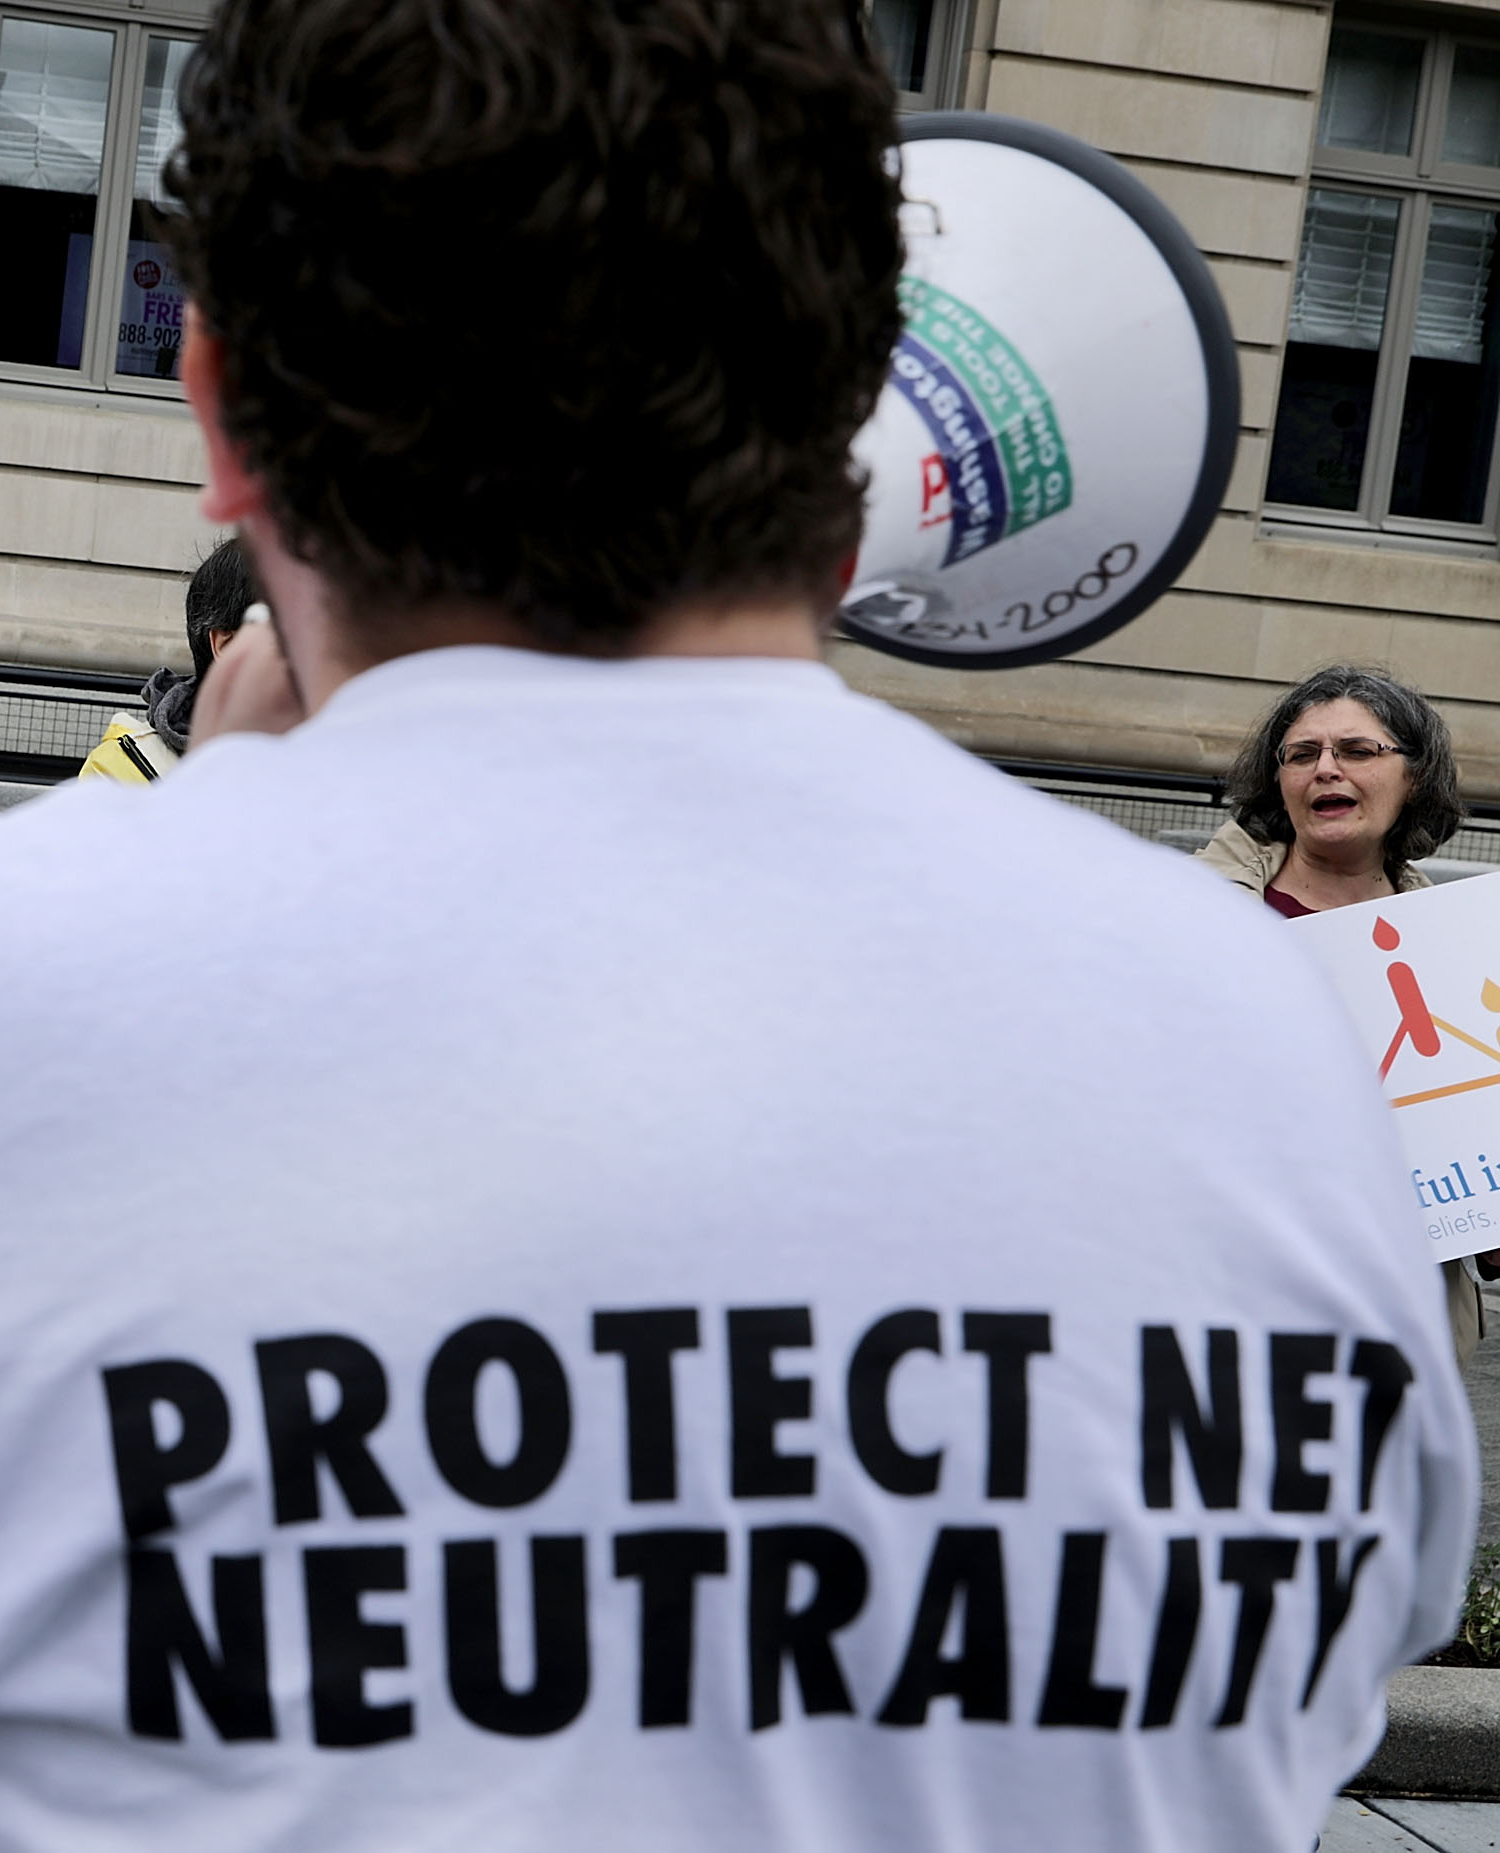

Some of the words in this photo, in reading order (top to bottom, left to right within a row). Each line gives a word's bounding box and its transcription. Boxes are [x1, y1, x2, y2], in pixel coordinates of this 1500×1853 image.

[891, 347, 992, 559] Washingto
[101, 1304, 1052, 1544] PROTECT
[1140, 1324, 1413, 1514] NET
[124, 1522, 1381, 1748] NEUTRALITY
